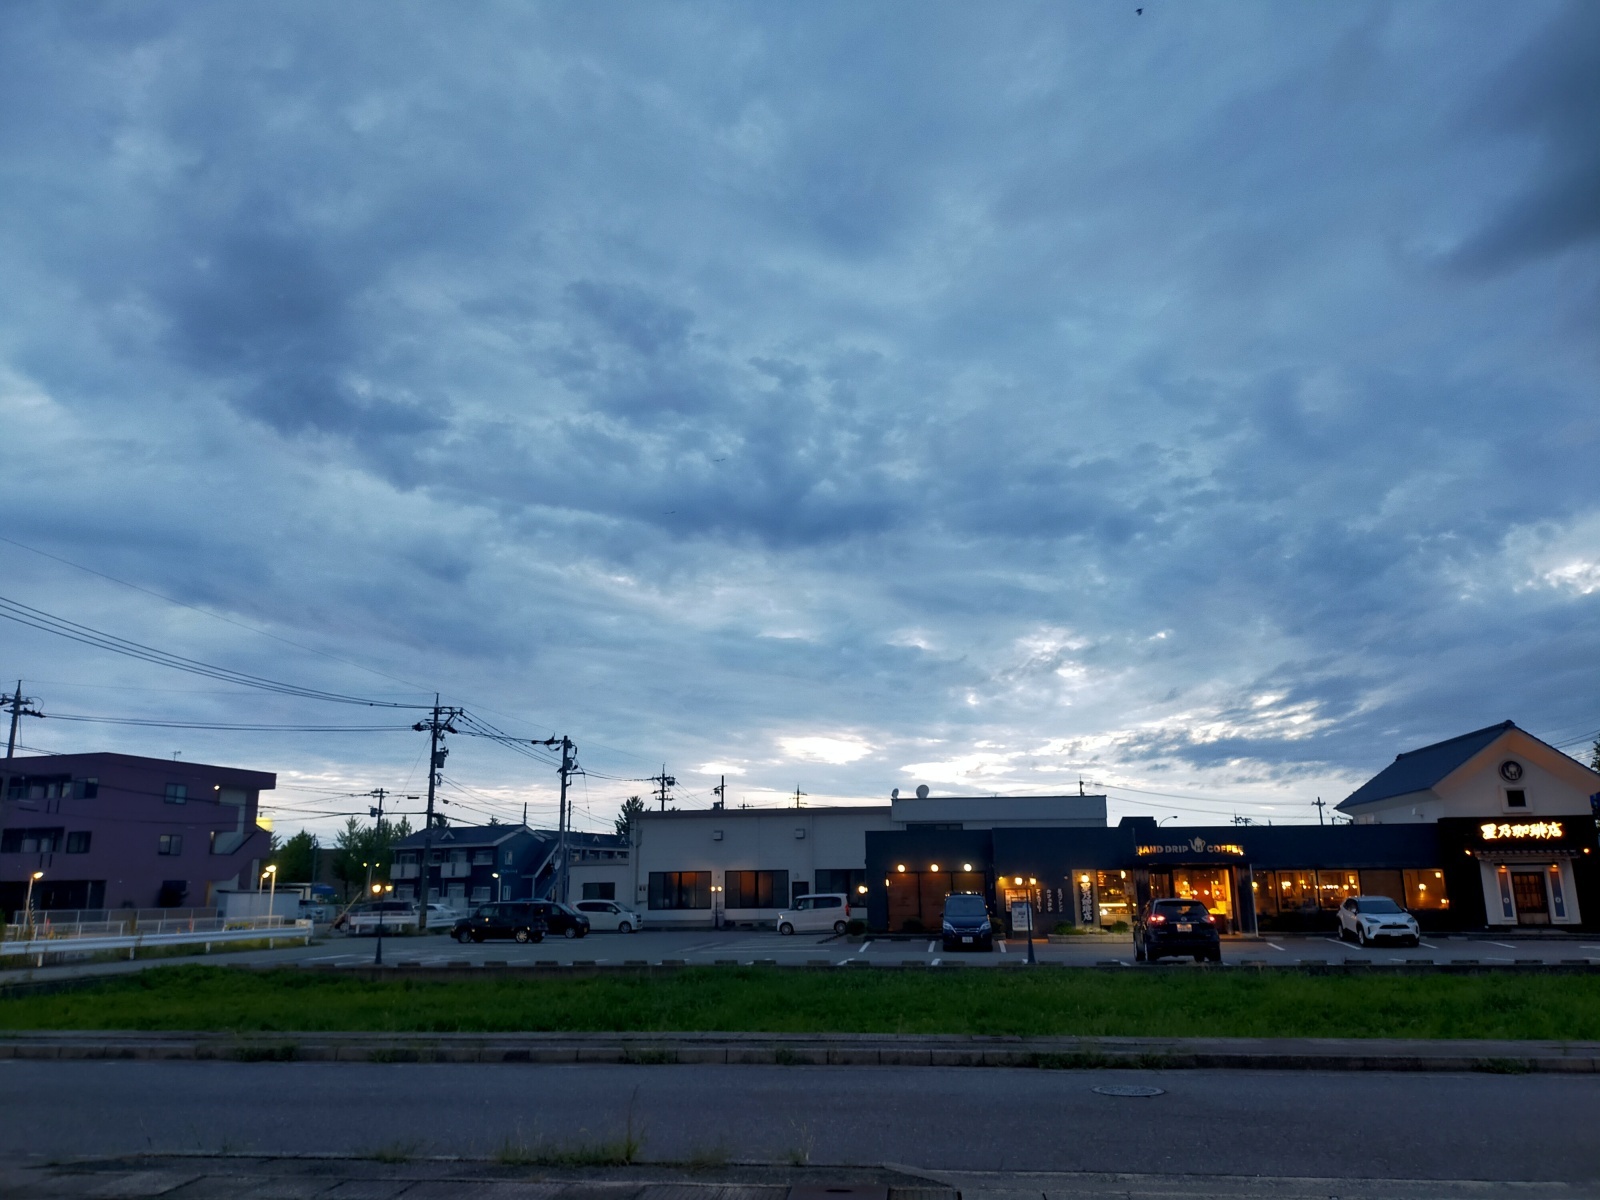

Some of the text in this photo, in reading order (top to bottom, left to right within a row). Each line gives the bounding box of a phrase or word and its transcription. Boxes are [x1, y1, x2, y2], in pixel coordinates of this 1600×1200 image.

[1136, 845, 1189, 854] HAND DRIP
[1206, 844, 1244, 854] COFFEE
